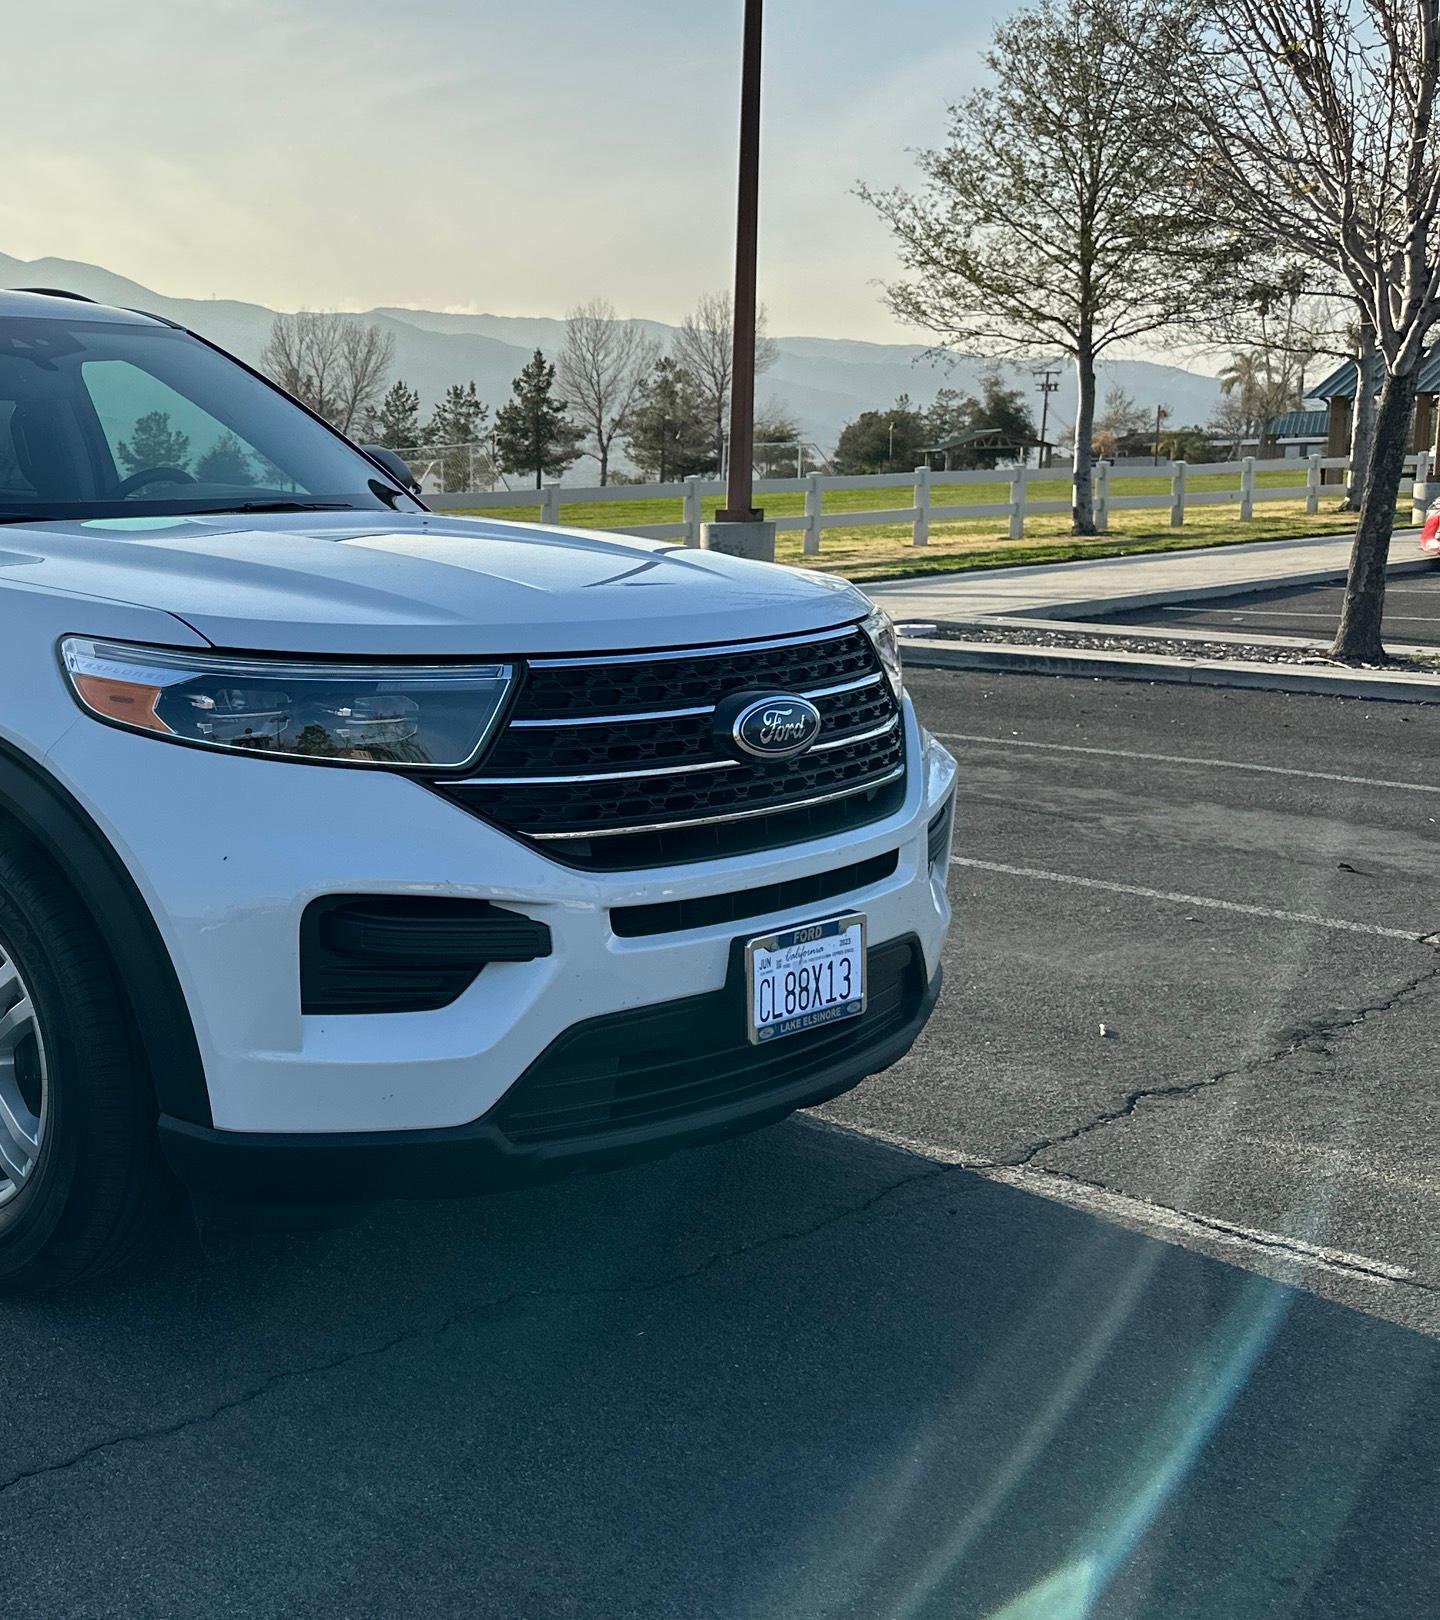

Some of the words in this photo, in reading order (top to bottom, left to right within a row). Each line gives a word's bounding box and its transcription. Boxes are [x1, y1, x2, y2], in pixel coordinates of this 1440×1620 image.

[760, 708, 806, 744] Ford
[793, 926, 822, 944] FORD
[759, 957, 772, 970] JUN
[785, 945, 824, 965] California
[759, 957, 852, 1023] CL88X13
[780, 1018, 801, 1033] LAKE
[802, 1007, 842, 1026] ELSINORE
